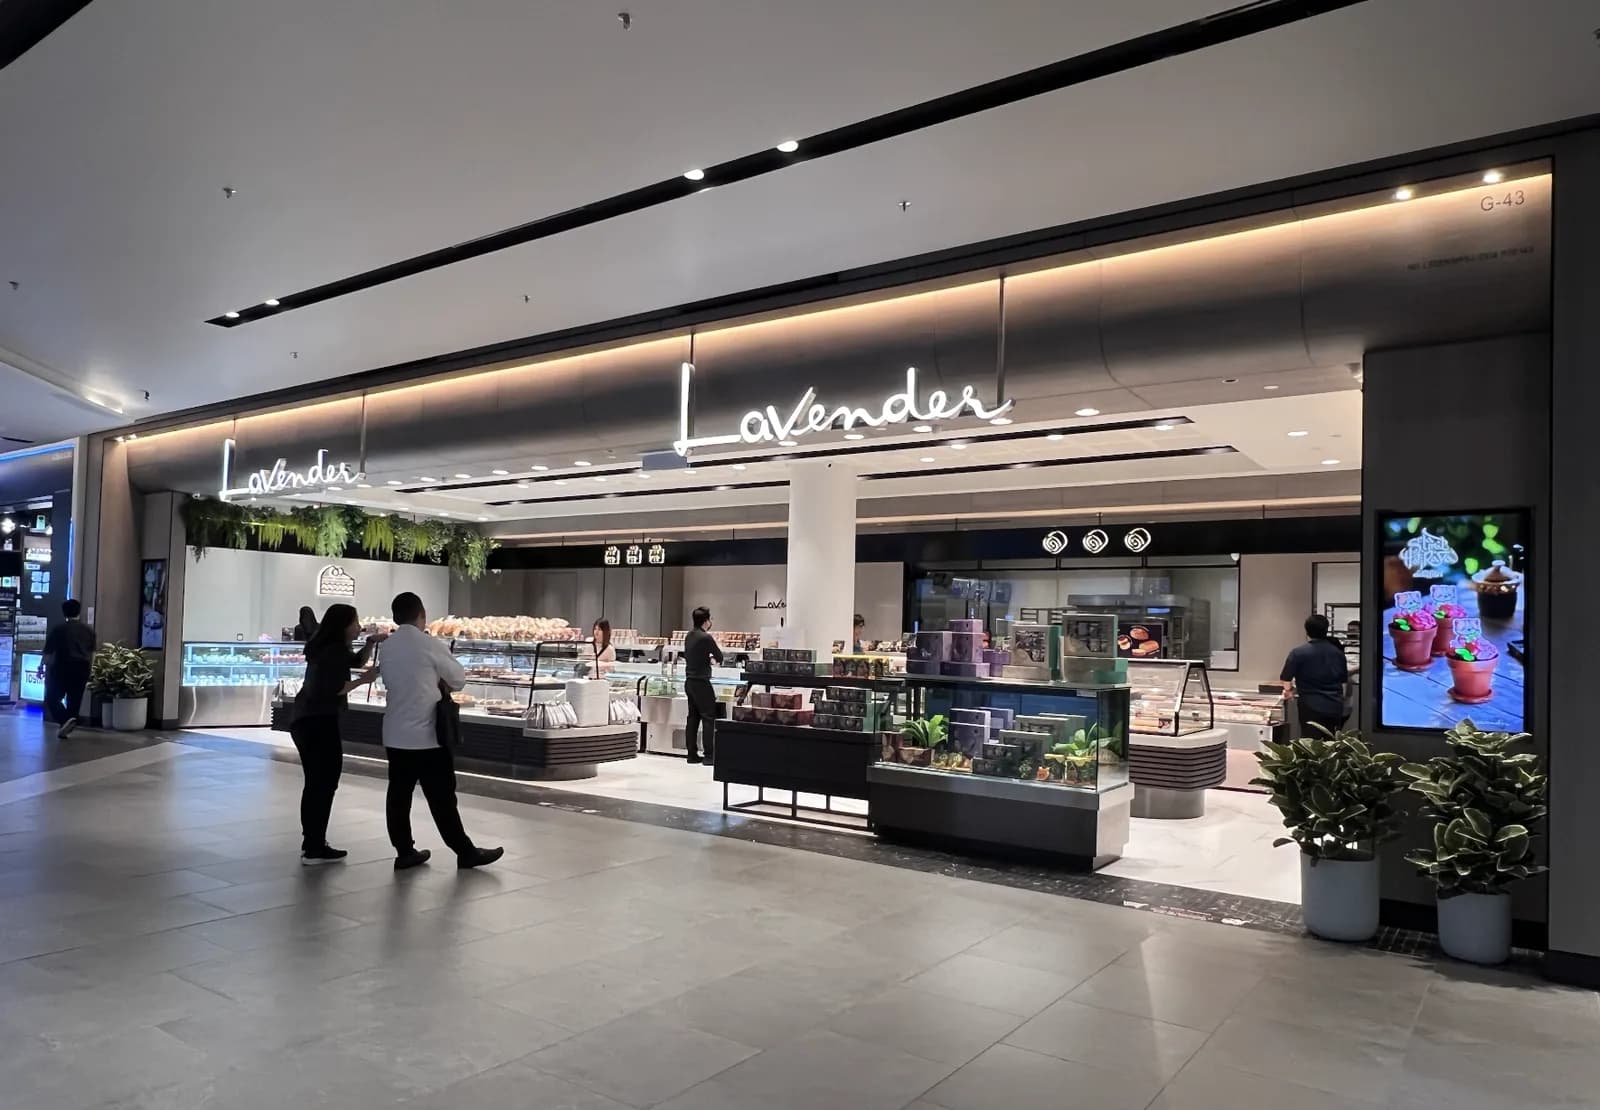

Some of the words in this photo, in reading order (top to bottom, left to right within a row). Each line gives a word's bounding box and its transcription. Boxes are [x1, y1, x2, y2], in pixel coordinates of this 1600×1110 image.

[1480, 190, 1525, 212] G-43
[673, 361, 1015, 457] Lavender
[218, 438, 363, 502] Lavender
